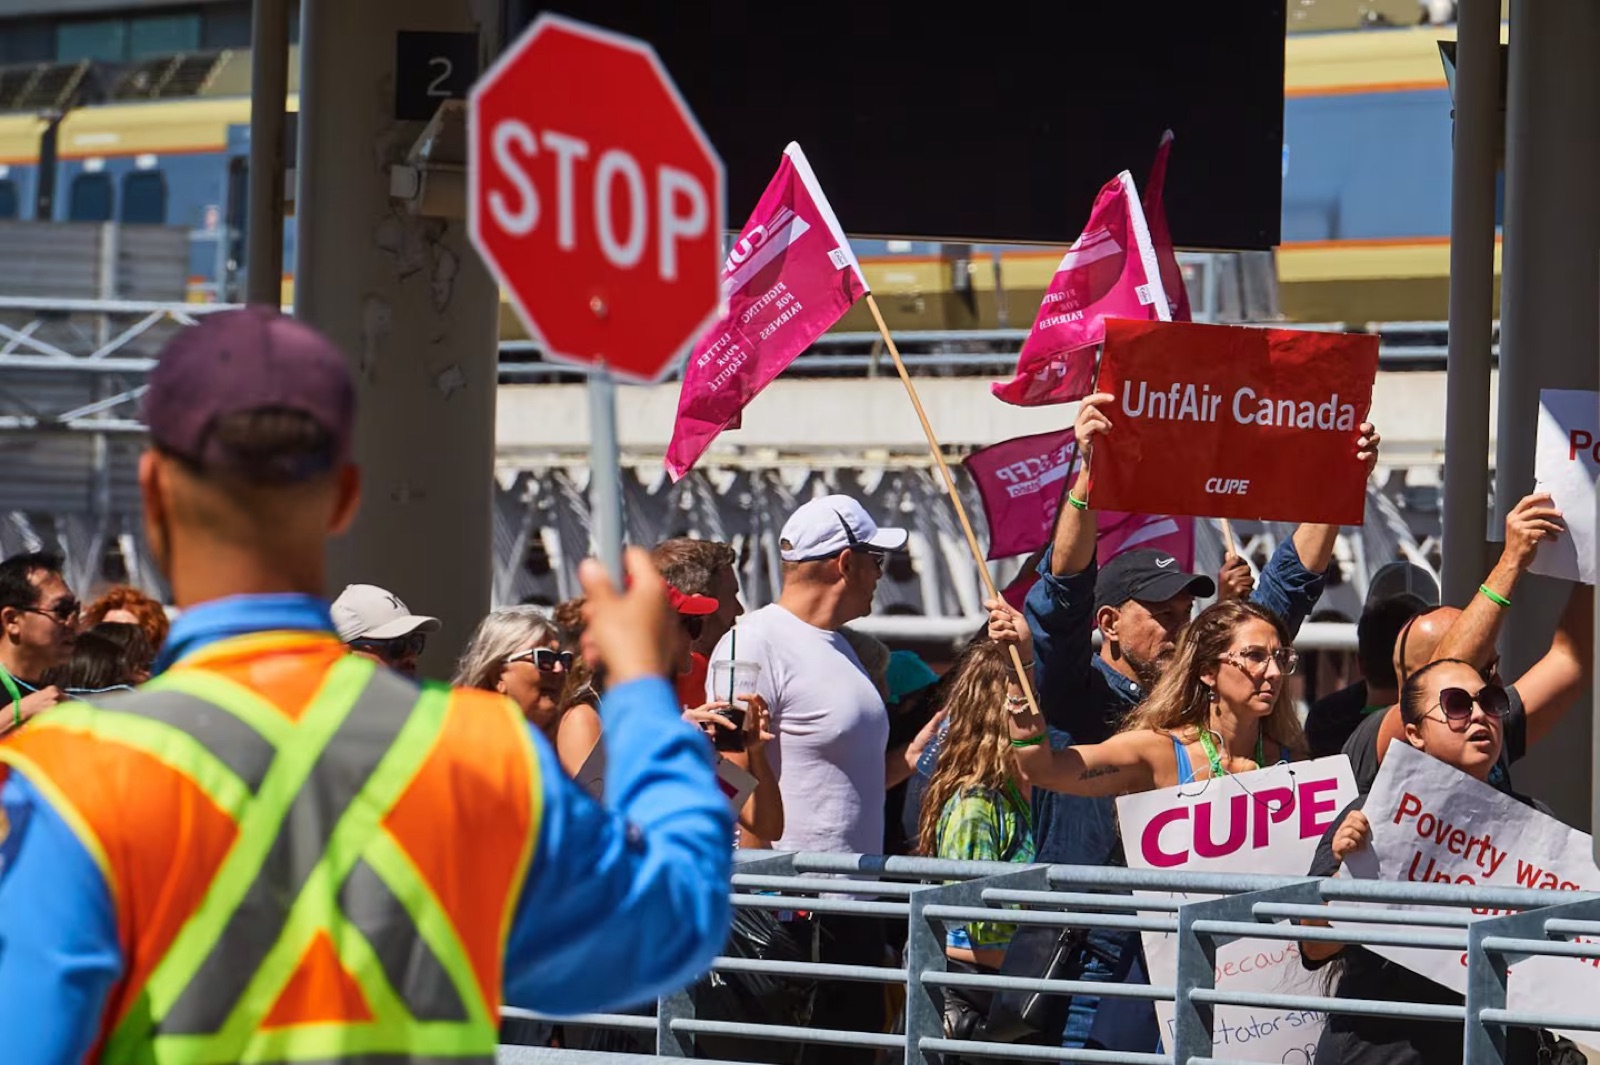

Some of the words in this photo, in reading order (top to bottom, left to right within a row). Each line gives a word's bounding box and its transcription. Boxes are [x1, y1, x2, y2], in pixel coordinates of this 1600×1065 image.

[427, 57, 452, 96] 2
[488, 118, 710, 282] STOP
[1121, 380, 1222, 422] UnfAir
[1232, 386, 1356, 431] Canada
[1204, 477, 1250, 496] CUPE
[1140, 777, 1338, 868] CUPE
[1393, 791, 1508, 879] Poverty
